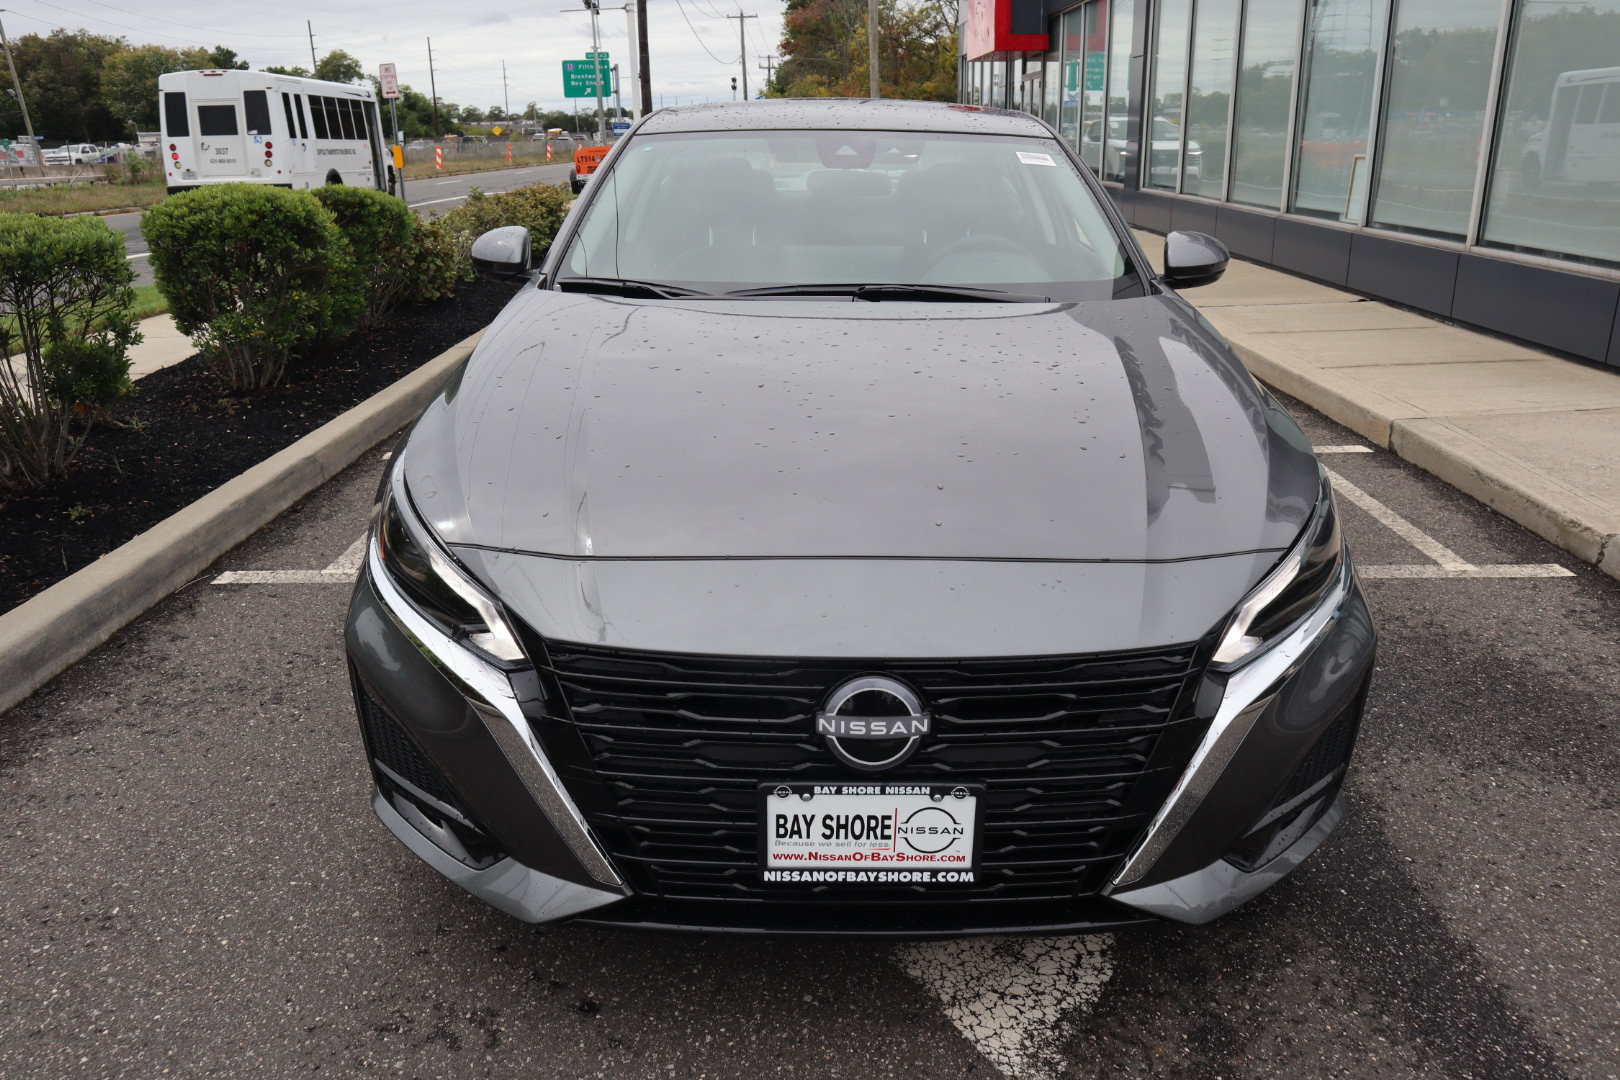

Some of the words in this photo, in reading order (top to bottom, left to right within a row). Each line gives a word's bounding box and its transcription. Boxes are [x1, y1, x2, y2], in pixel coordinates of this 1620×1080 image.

[818, 718, 928, 735] NISSAN
[813, 786, 838, 795] BAY
[841, 786, 881, 795] SHORE
[885, 786, 930, 795] NISSAN
[775, 814, 816, 840] BAY
[821, 814, 893, 840] SHORE
[897, 826, 964, 835] NISSAN
[836, 840, 851, 848] sell
[854, 840, 867, 848] for
[763, 871, 975, 883] NISSANOFBAYSHORE.COM
